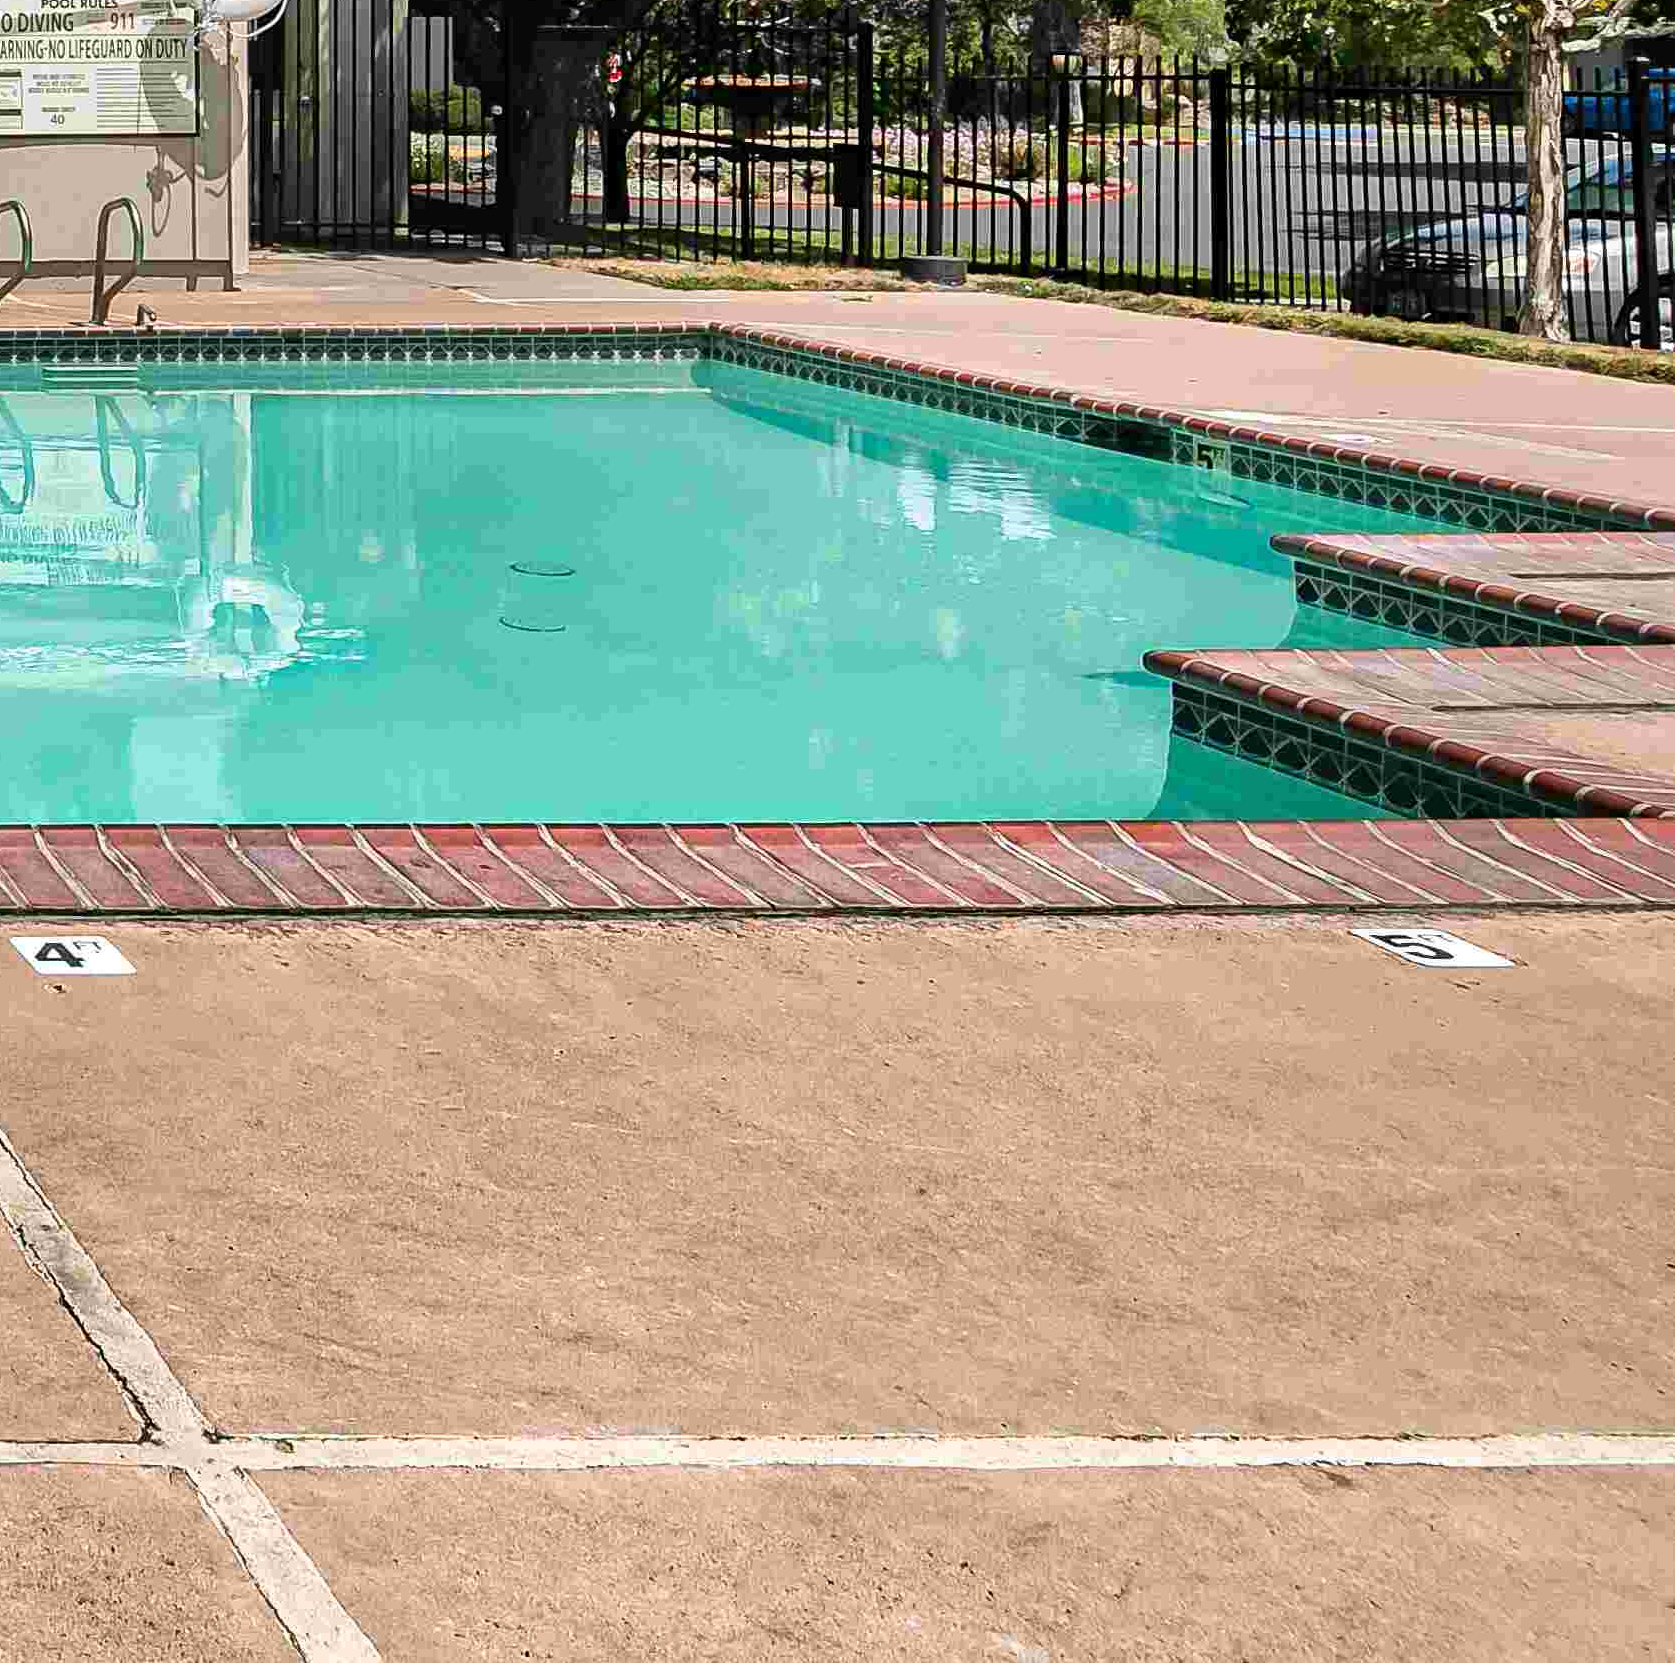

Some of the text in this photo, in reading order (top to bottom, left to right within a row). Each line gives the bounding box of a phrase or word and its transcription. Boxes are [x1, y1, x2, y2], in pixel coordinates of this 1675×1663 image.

[18, 13, 74, 33] DIVING
[110, 12, 136, 30] 911
[69, 39, 132, 59] LIFEGUARD
[136, 39, 153, 58] ON
[156, 39, 186, 58] DUTY
[50, 113, 65, 124] 40
[1198, 443, 1213, 470] 5
[34, 942, 86, 968] 4
[1368, 934, 1455, 959] 5
